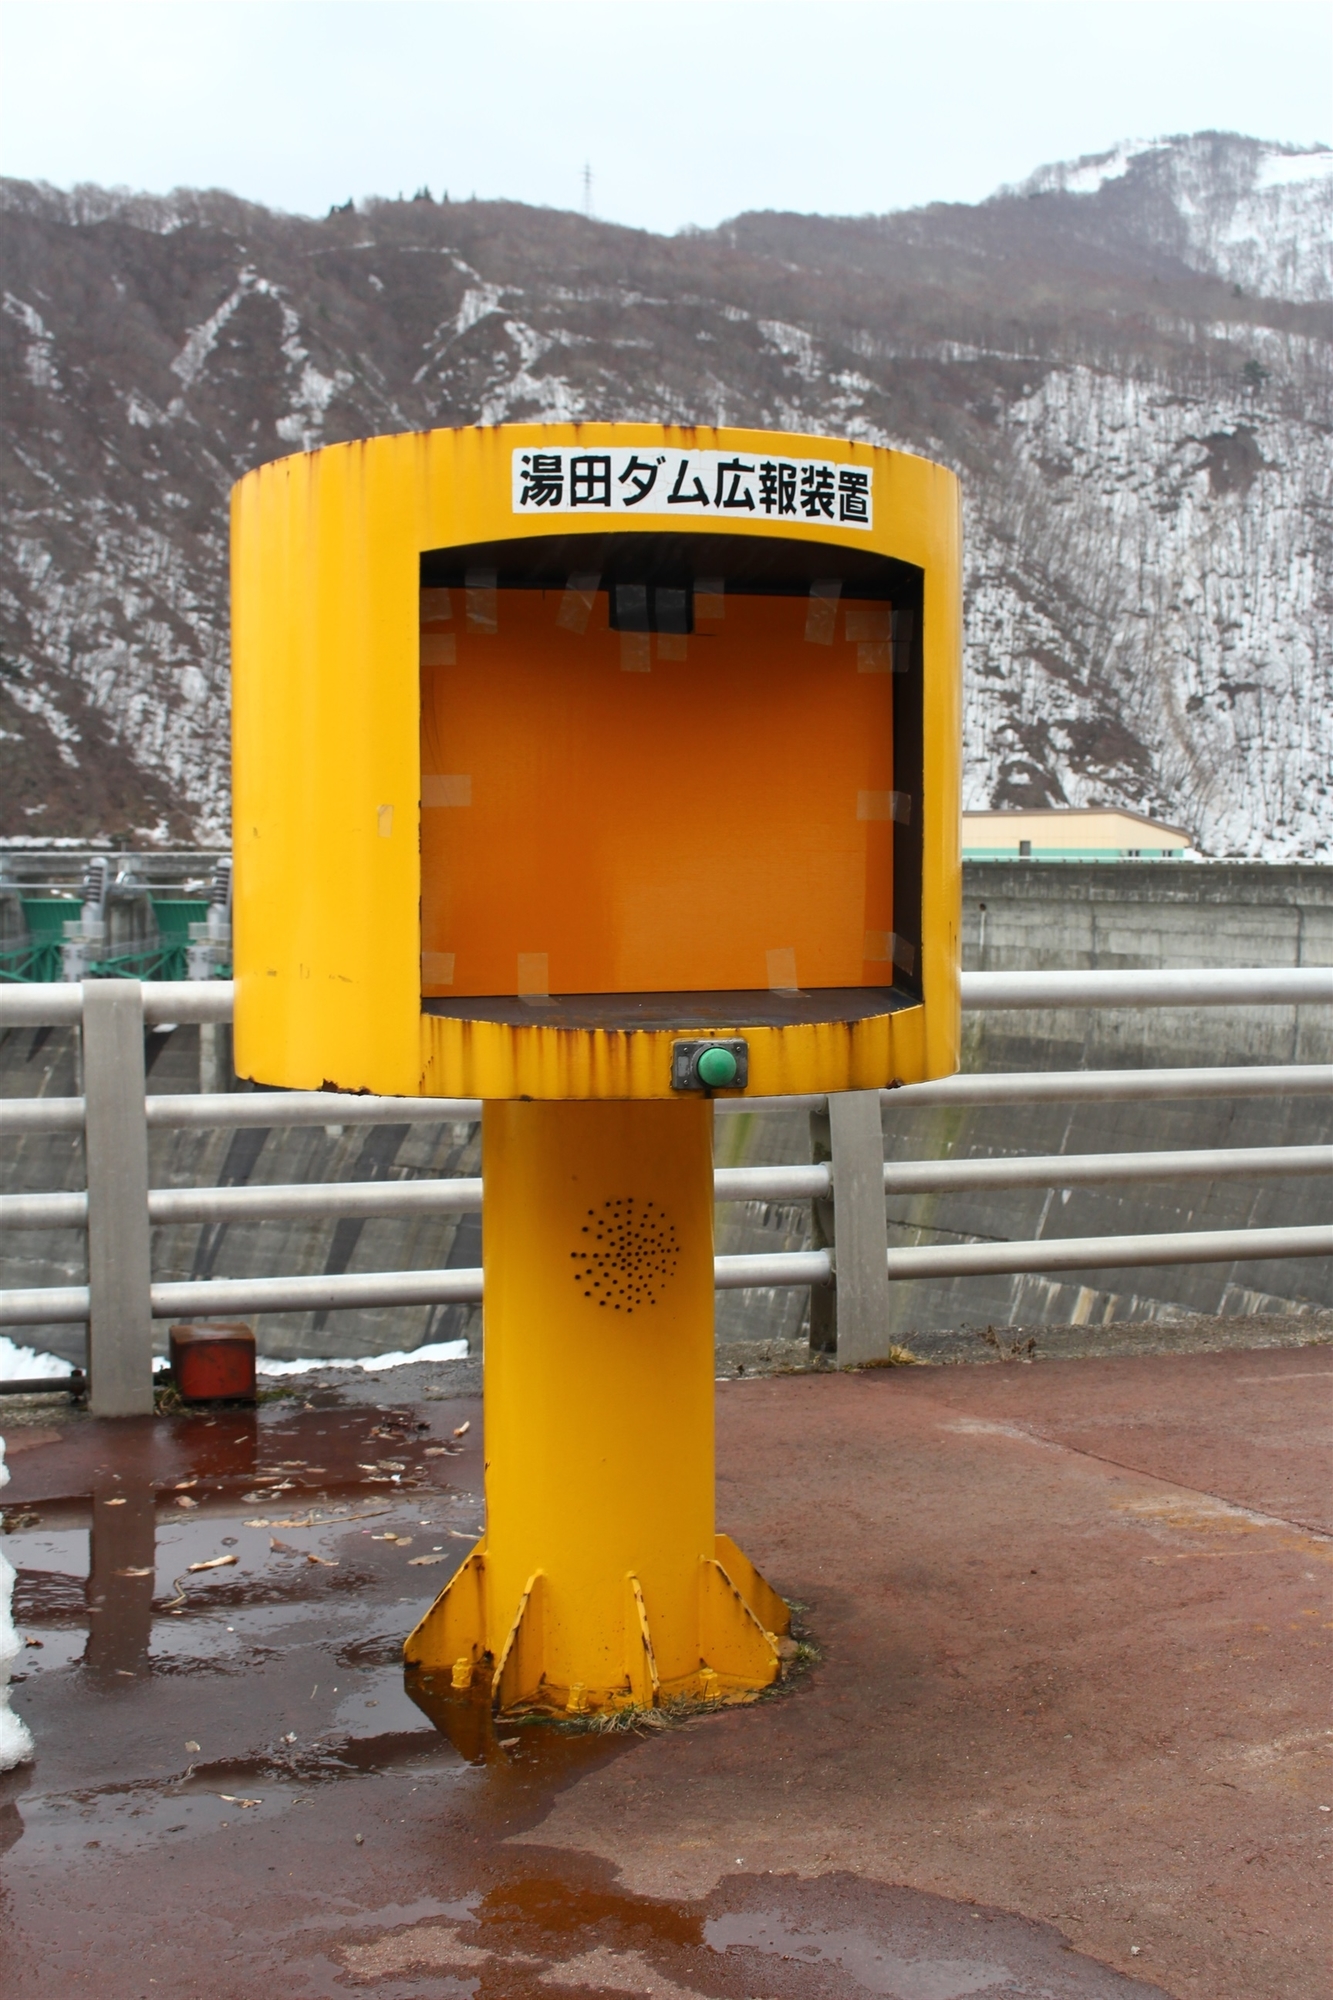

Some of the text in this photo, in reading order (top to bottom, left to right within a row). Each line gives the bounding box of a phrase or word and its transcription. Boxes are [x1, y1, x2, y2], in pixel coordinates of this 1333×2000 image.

[519, 454, 869, 523] 湯田ダム広報装置
